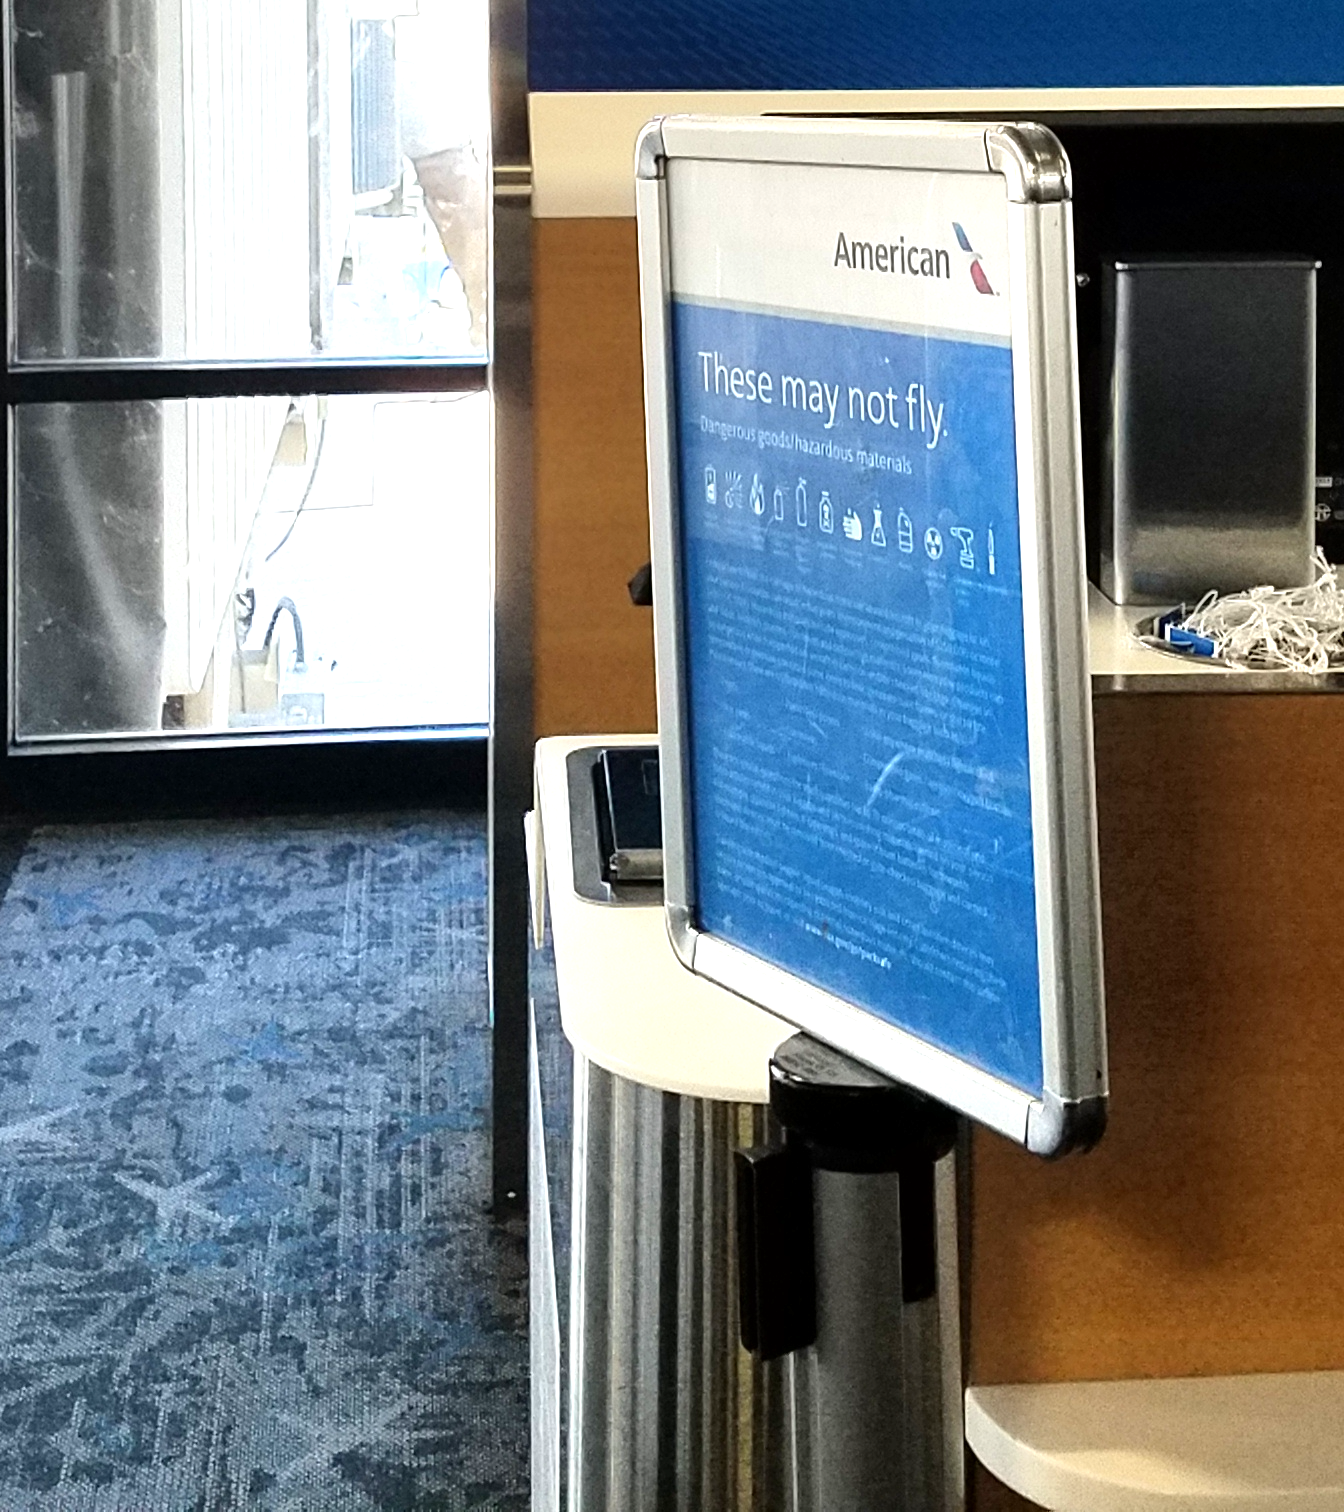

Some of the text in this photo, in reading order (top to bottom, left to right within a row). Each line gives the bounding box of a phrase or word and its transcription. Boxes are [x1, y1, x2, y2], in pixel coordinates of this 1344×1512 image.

[834, 232, 950, 279] American
[698, 352, 948, 449] These may not fly.
[701, 415, 755, 442] Dangerous
[857, 449, 912, 474] materials
